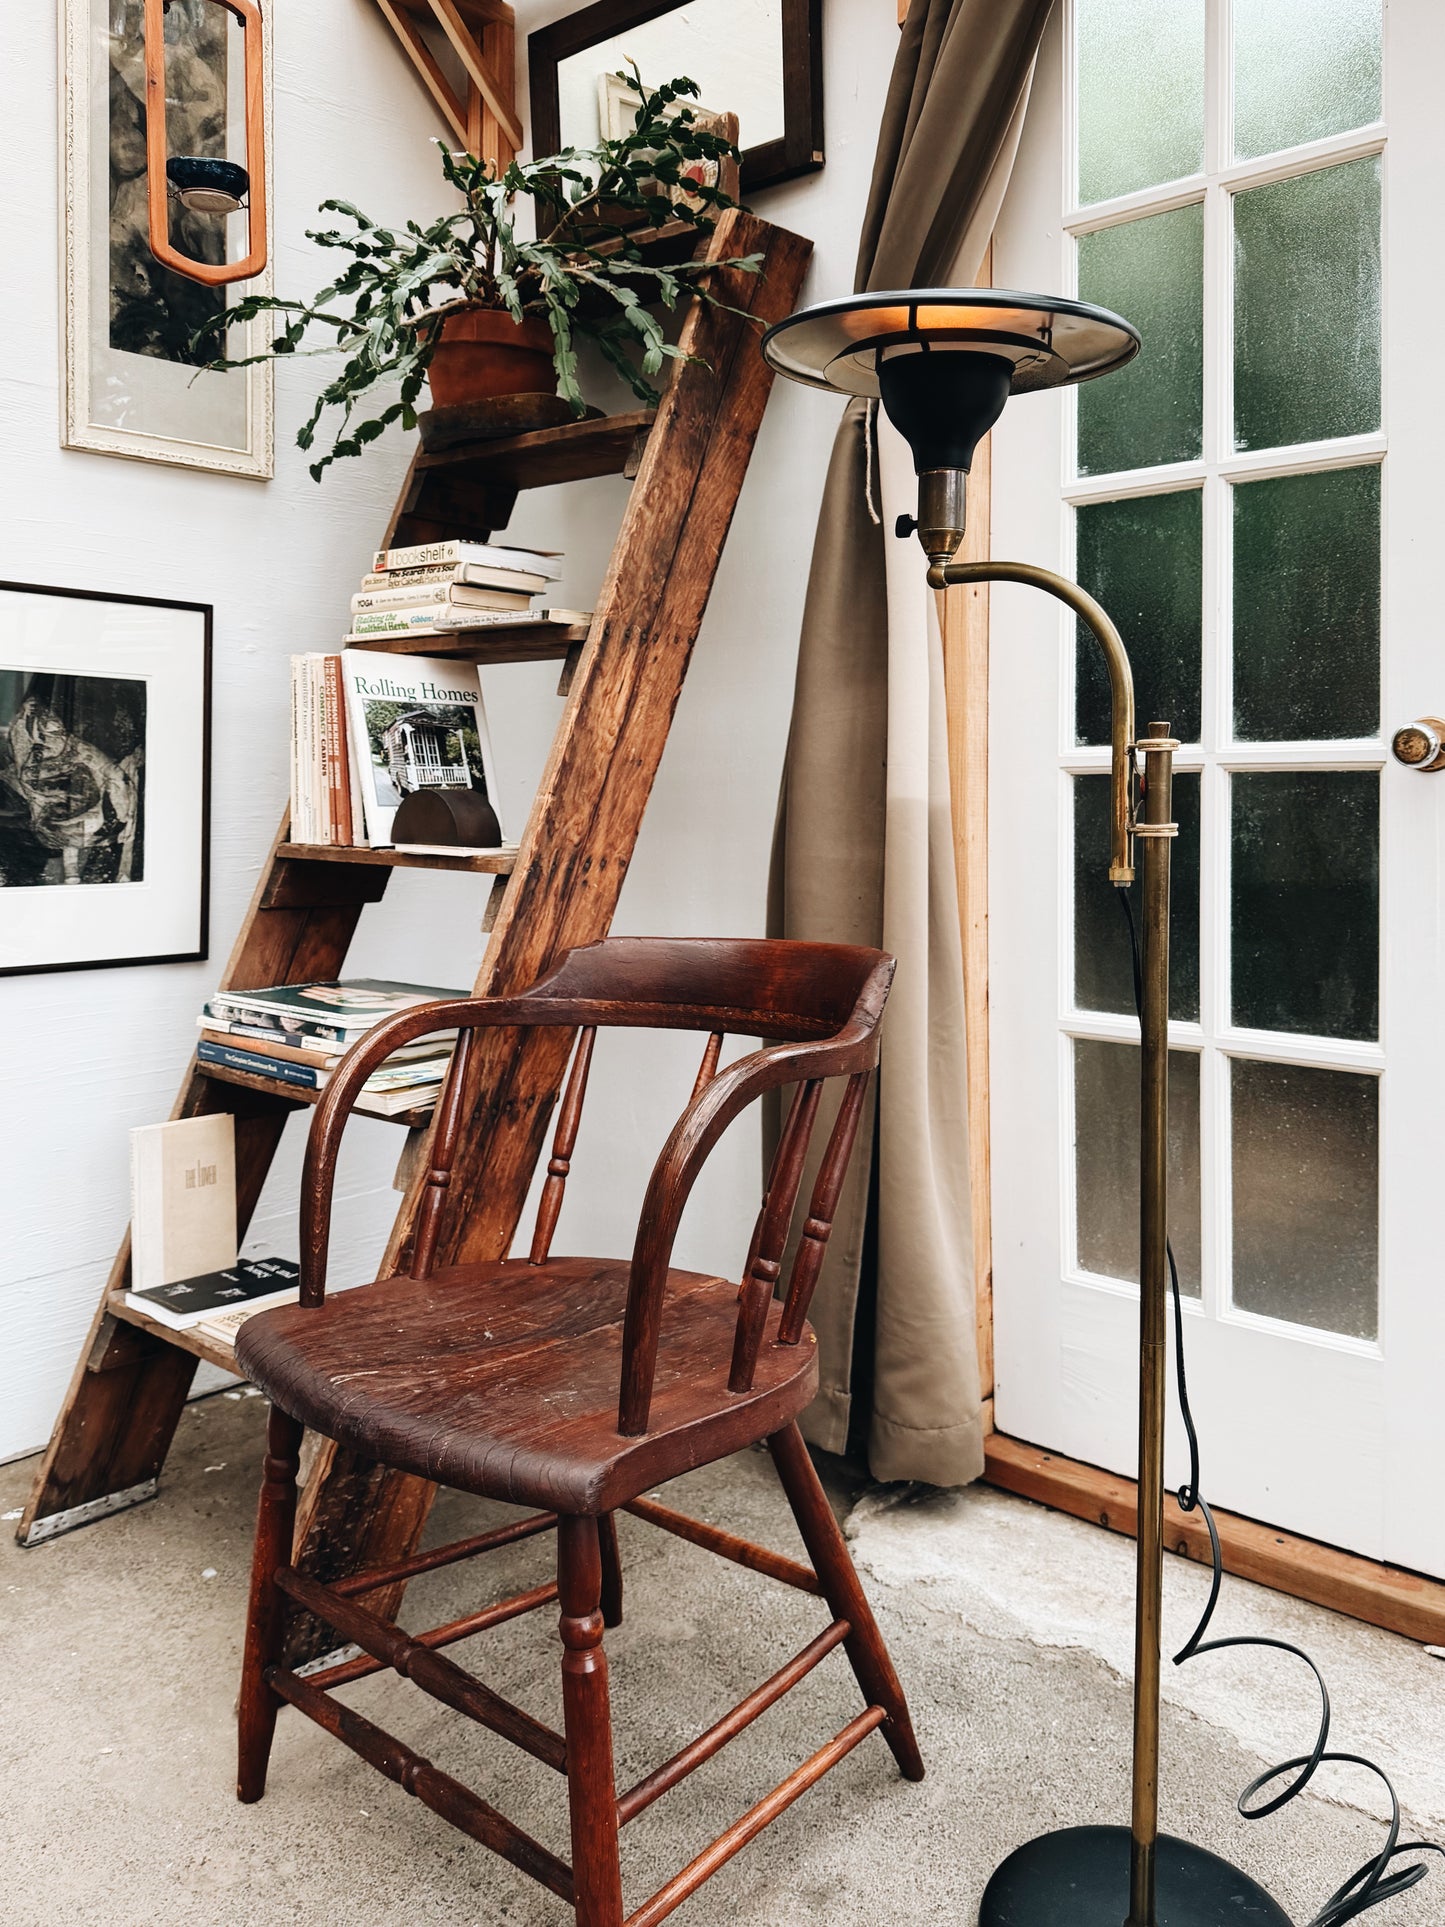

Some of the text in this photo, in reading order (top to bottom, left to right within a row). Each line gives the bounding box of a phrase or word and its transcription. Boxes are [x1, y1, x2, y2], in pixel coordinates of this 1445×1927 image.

[395, 544, 446, 565] bookshelf
[402, 567, 425, 577] Search
[357, 599, 373, 608] YOGA
[356, 615, 385, 627] Stalking
[354, 676, 479, 703] Rolling Homes
